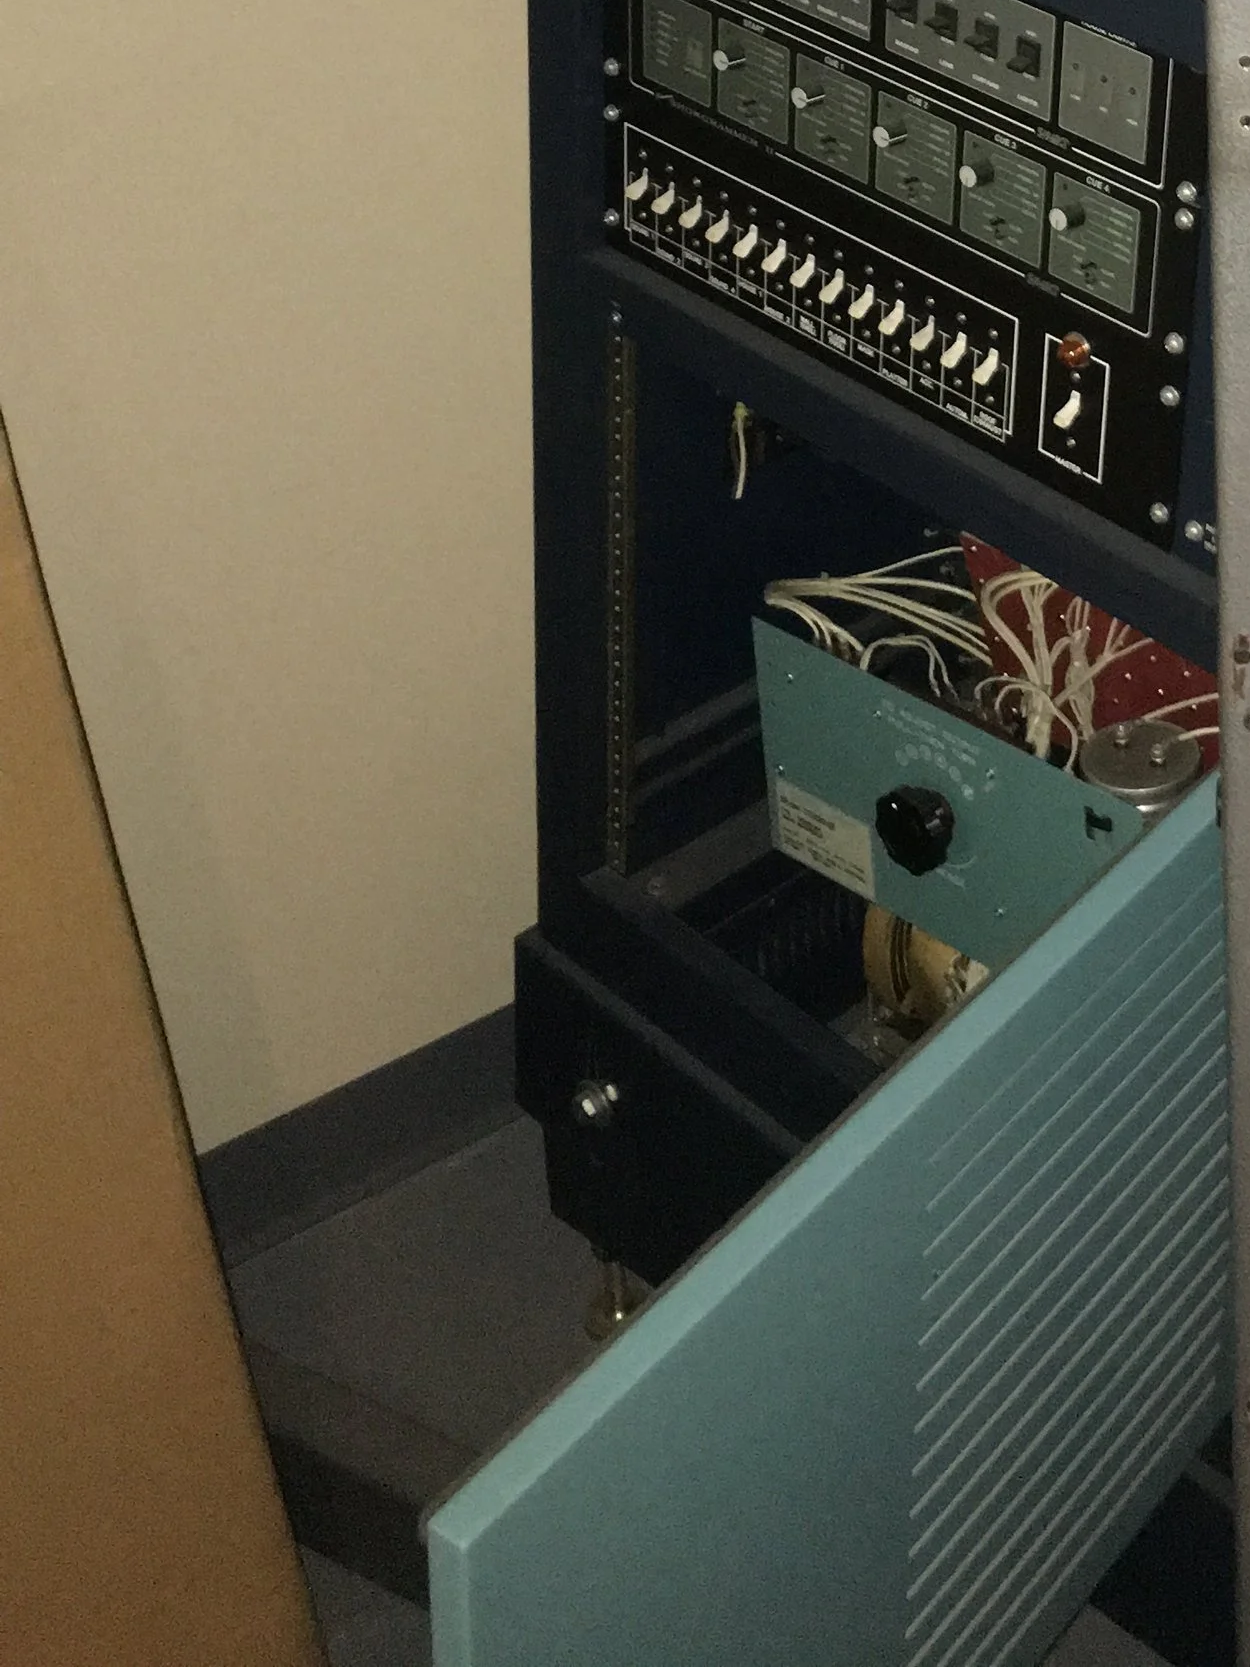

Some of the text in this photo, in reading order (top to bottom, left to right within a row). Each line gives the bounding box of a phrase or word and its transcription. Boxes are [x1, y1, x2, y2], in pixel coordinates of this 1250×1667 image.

[906, 94, 923, 108] CUE
[993, 133, 1010, 147] CUE
[1085, 175, 1103, 190] CUE
